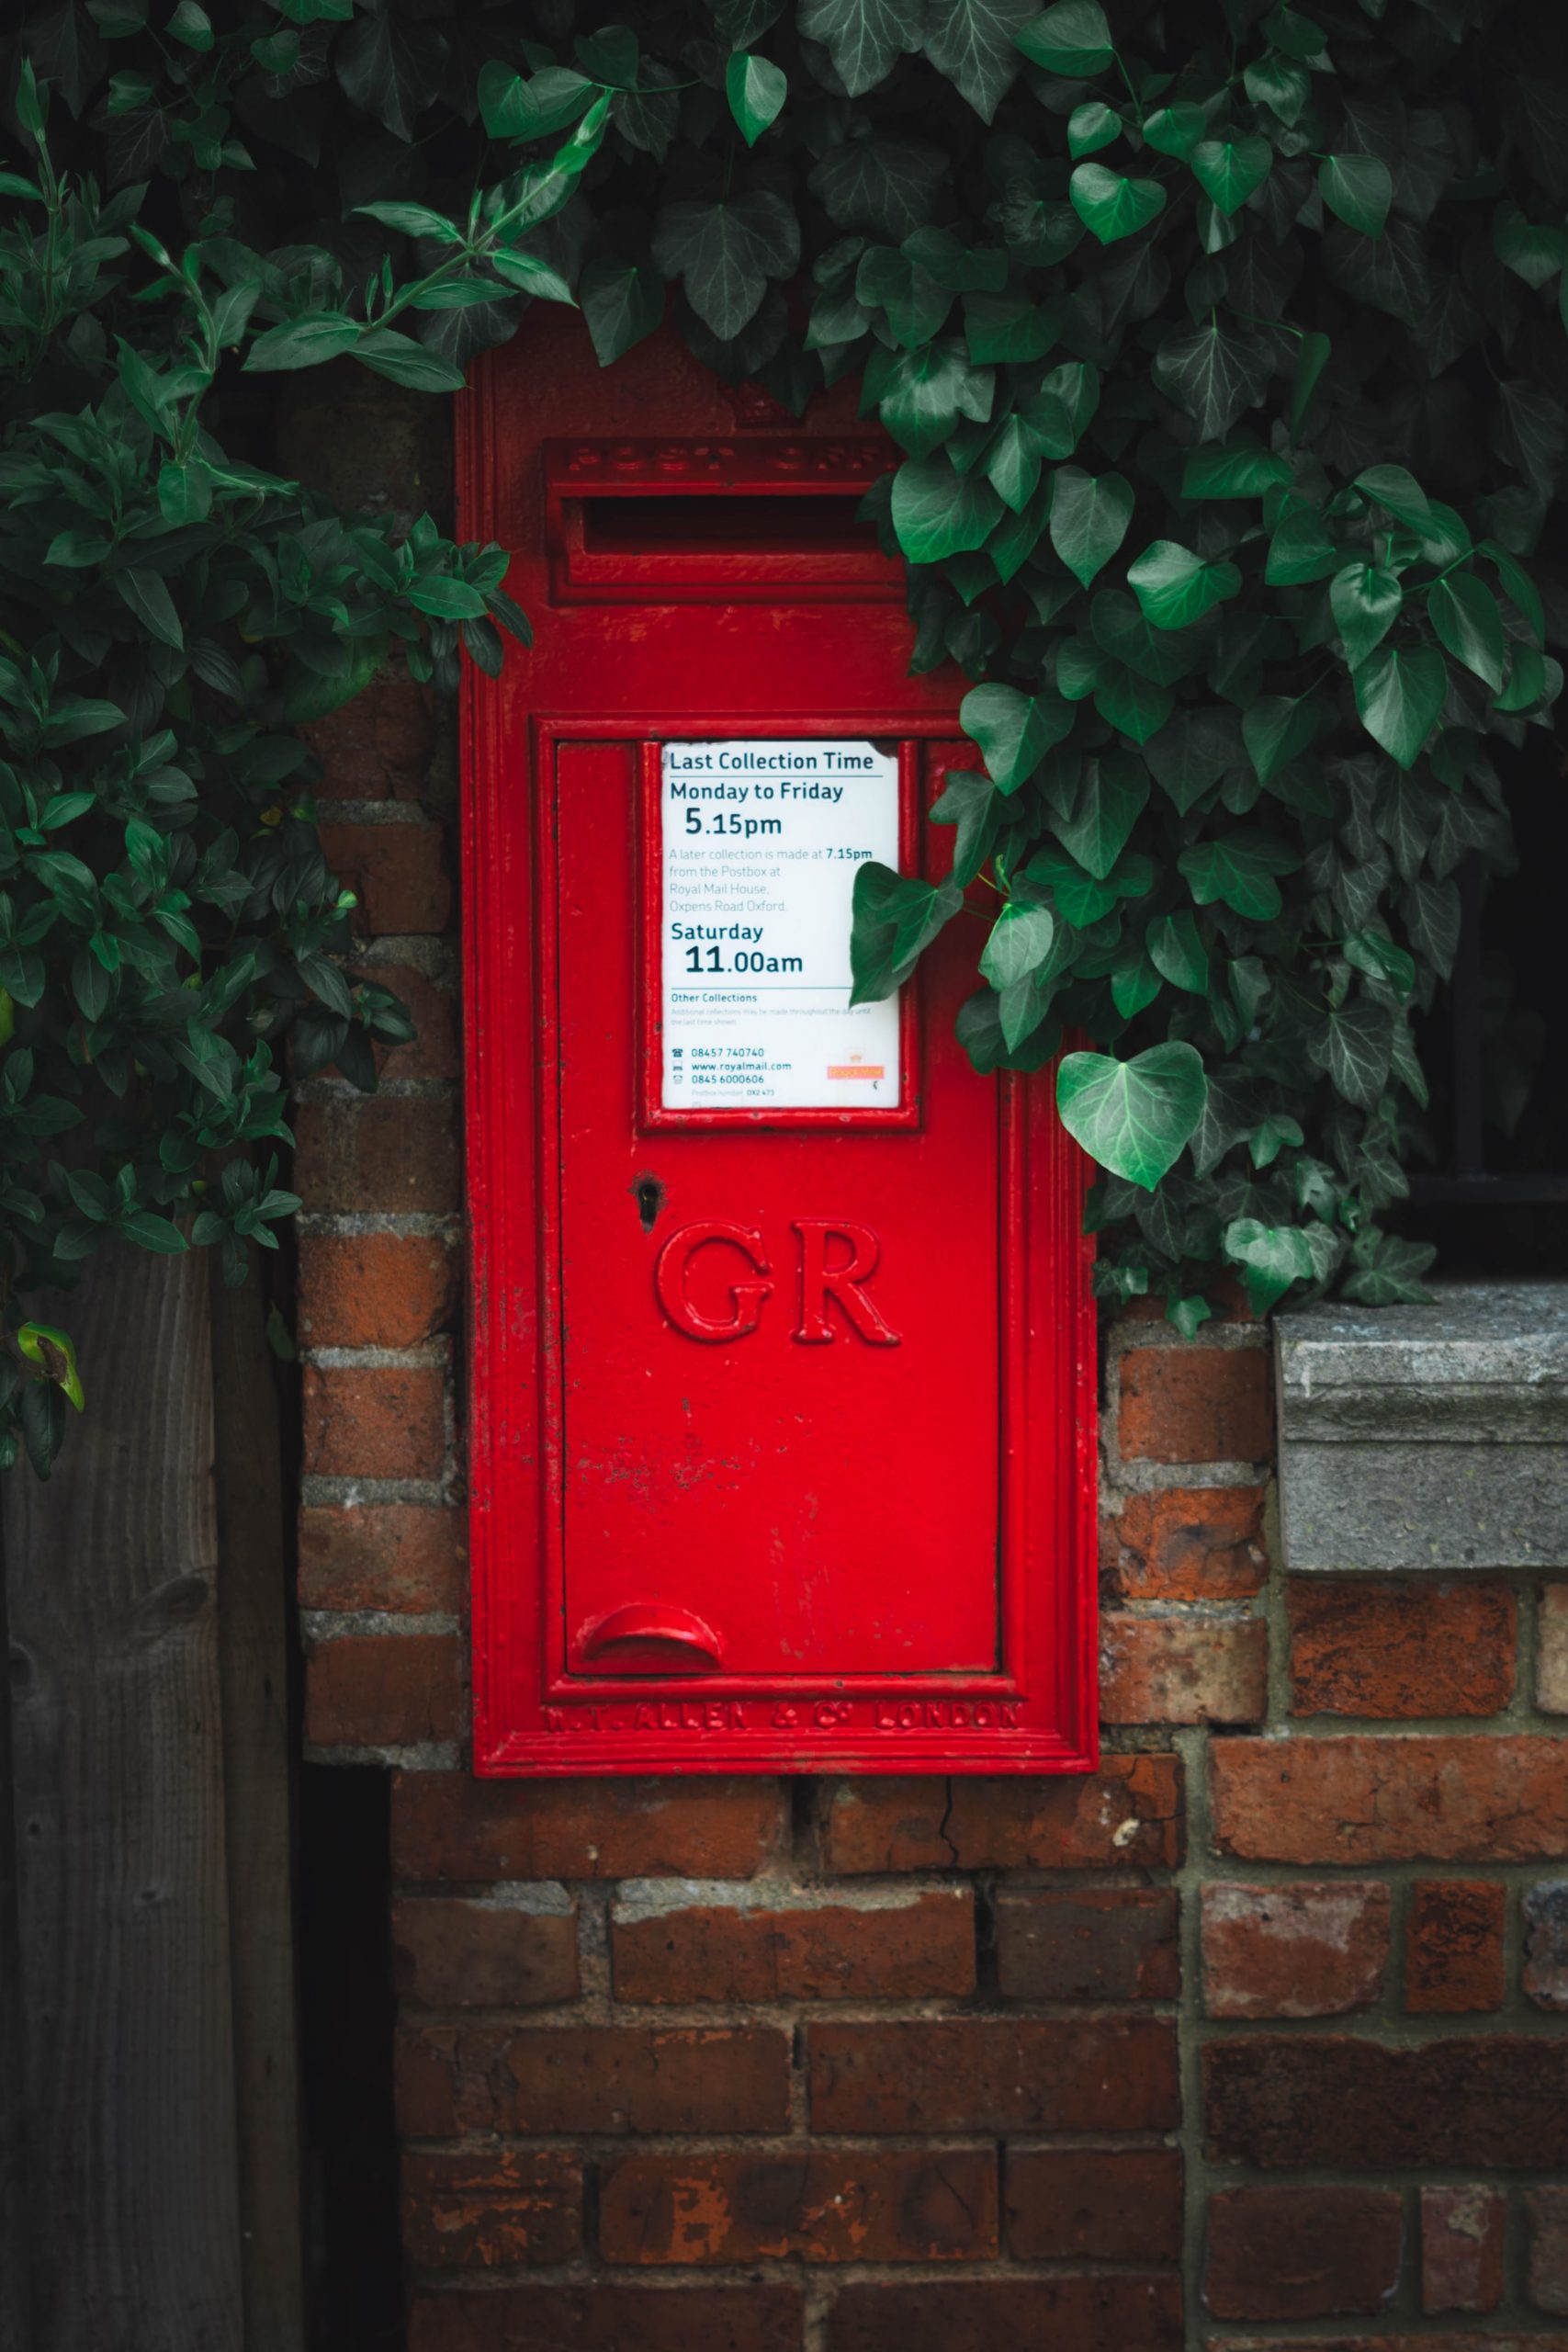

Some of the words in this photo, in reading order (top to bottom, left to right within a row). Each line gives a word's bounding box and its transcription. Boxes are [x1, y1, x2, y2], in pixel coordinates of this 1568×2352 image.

[567, 447, 735, 470] POST
[670, 752, 714, 770] Last
[718, 752, 818, 770] Collection
[822, 752, 874, 770] Time
[670, 782, 749, 803] Monday
[755, 784, 774, 800] to
[780, 782, 843, 803] Friday
[685, 807, 782, 839] 5.15pm
[669, 849, 678, 860] A
[680, 849, 705, 860] later
[708, 848, 762, 860] collection
[765, 849, 773, 860] is
[776, 848, 808, 860] made
[811, 850, 823, 860] at
[826, 848, 873, 861] 7.15pm
[669, 866, 697, 877] from
[700, 866, 718, 877] the
[721, 866, 767, 877] Postbox
[770, 867, 781, 877] at
[669, 884, 701, 897] Royal
[704, 884, 728, 895] Mail
[669, 900, 712, 913] Oxpens
[715, 900, 744, 912] Road
[671, 922, 763, 944] Saturday
[685, 945, 803, 973] 11.00am
[671, 992, 699, 1003] Other
[702, 992, 758, 1003] Collections
[691, 1047, 723, 1057] 08457
[726, 1047, 764, 1057] 740740
[692, 1061, 792, 1072] www.royalmail.com
[691, 1074, 717, 1084] 0845
[719, 1074, 764, 1084] 6000606
[653, 1217, 902, 1348] GR
[634, 1702, 748, 1731] ALLEN
[771, 1702, 799, 1730] &
[874, 1702, 1023, 1729] LONDON
